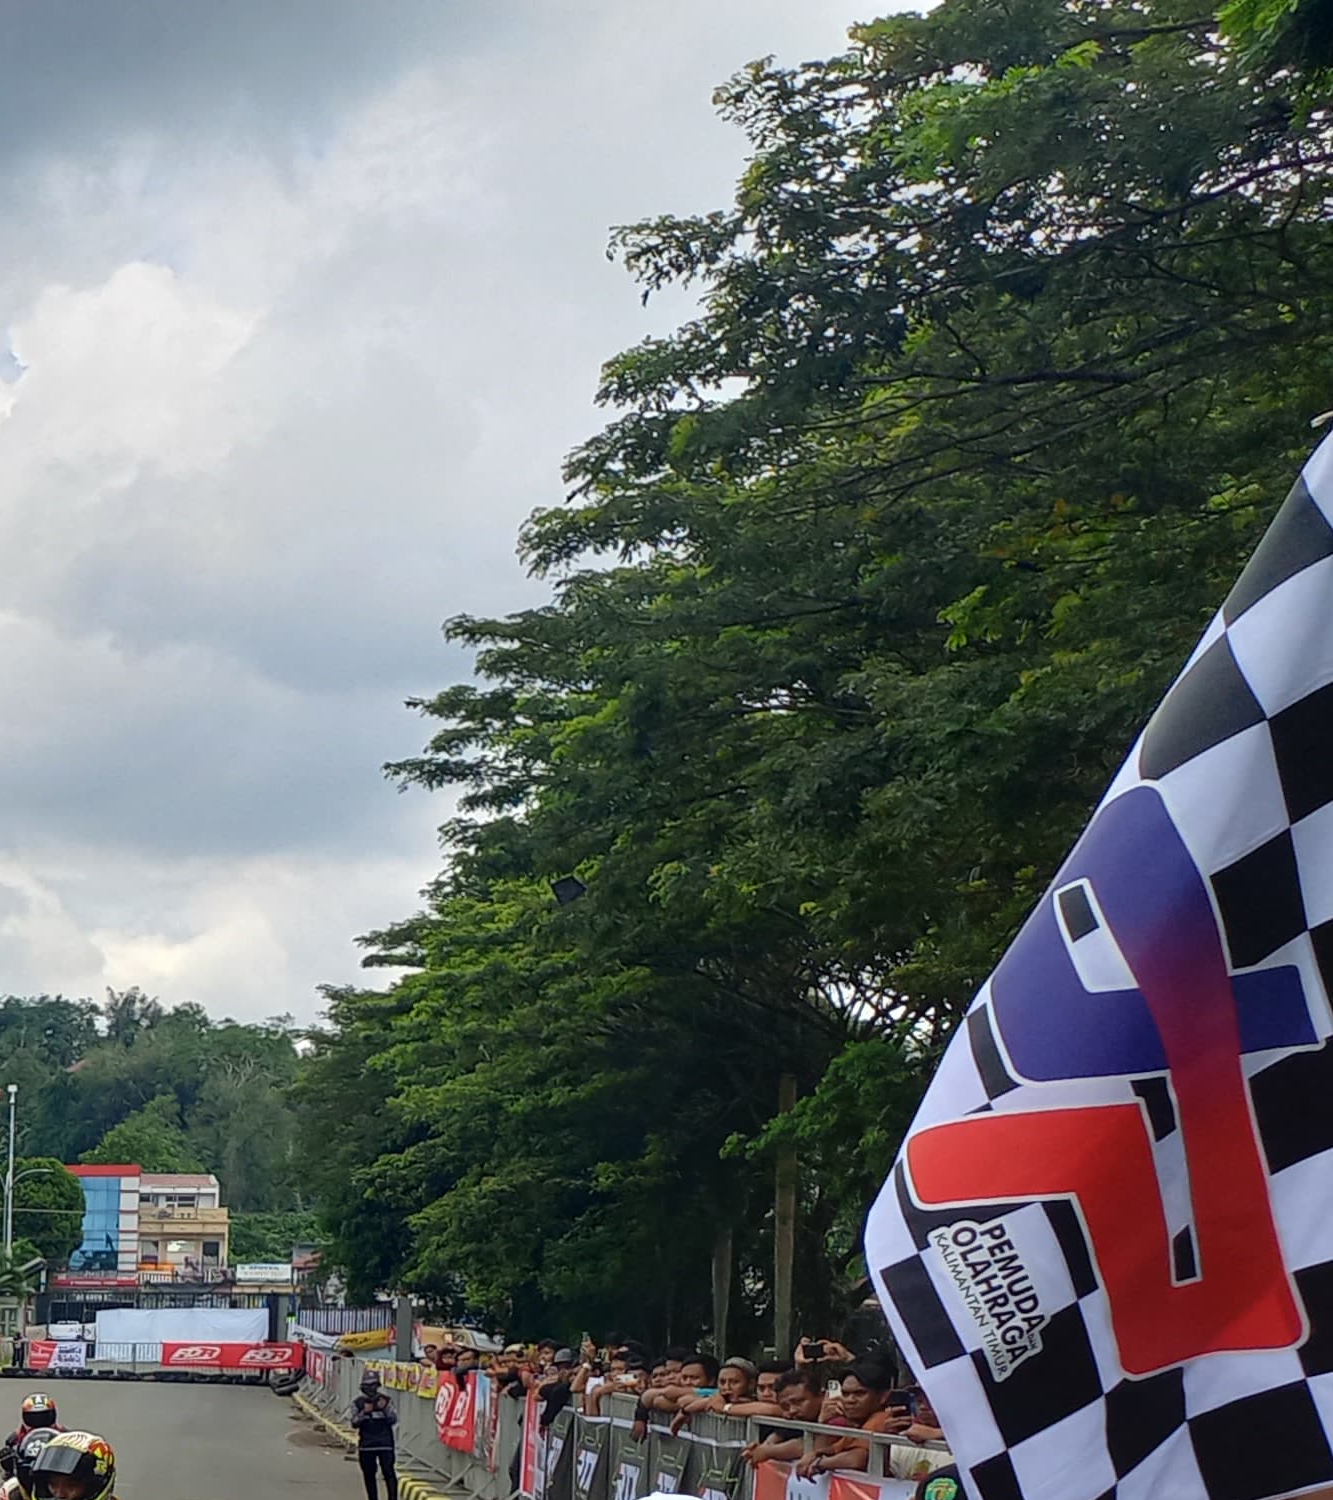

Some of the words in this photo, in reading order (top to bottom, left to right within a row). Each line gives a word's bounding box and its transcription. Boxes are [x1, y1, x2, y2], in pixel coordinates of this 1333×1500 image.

[934, 1232, 989, 1327] KALIMANTAN
[983, 1329, 1008, 1374] TIMUR
[951, 1227, 1029, 1364] OLAHRAGA
[980, 1223, 1046, 1333] PEMUDA
